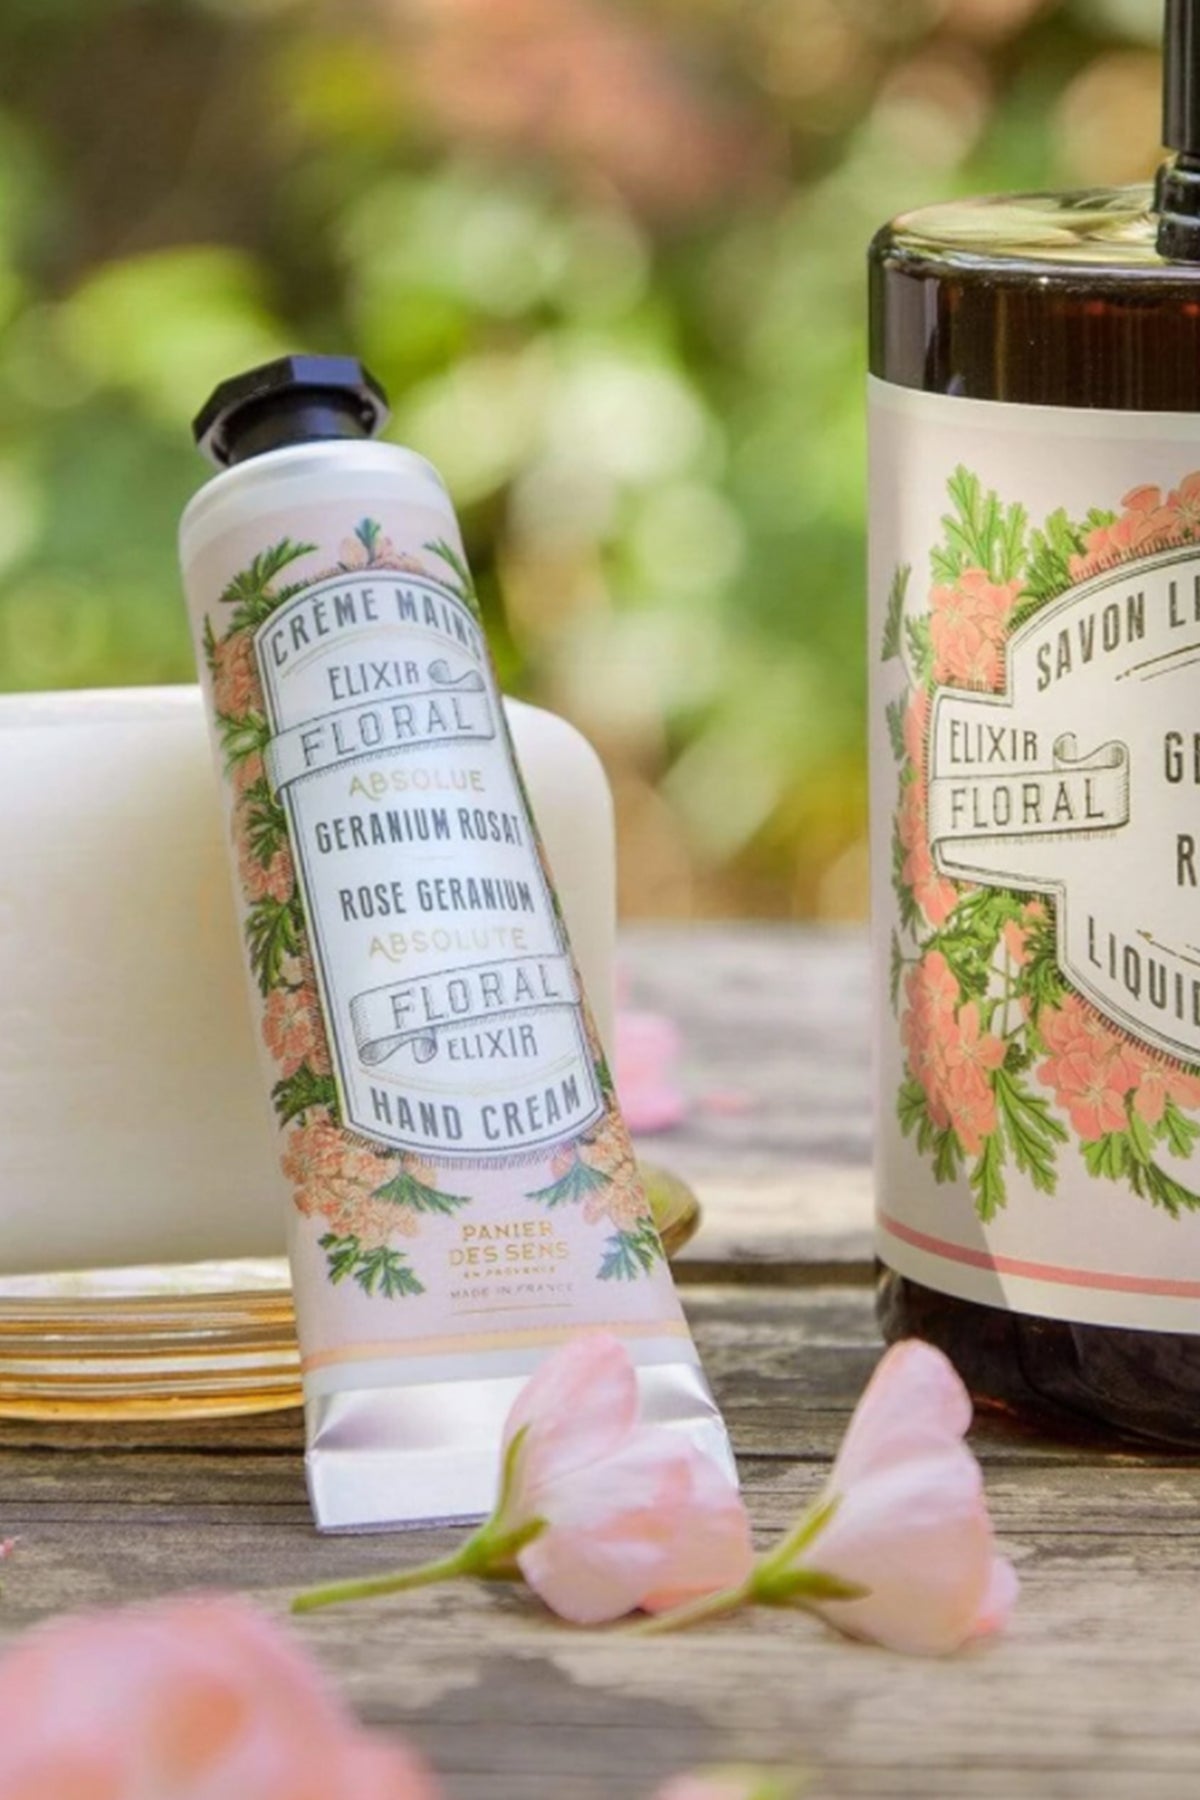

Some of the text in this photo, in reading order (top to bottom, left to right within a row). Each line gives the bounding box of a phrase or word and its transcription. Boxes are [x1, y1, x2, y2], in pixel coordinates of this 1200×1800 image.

[271, 588, 378, 667] CRÈME
[1037, 592, 1145, 692] SAVON
[328, 660, 420, 701] ELIXIR
[301, 697, 473, 767] FLORAL
[950, 719, 1038, 764] ELIXIR
[349, 770, 485, 801] ABSOLUE
[951, 777, 1105, 829] FLORAL
[315, 807, 523, 854] GERANIUM ROSAT
[339, 877, 535, 922] ROSE GERANIUM
[369, 927, 529, 963] ABSOLUTE
[390, 963, 559, 1030] FLORAL
[447, 1023, 538, 1060] ELIXIR
[370, 1074, 580, 1140] HAND CREAM
[448, 1241, 569, 1266] DES SENS
[462, 1221, 553, 1242] PANIER
[450, 1281, 573, 1299] MADE IN FRANCE
